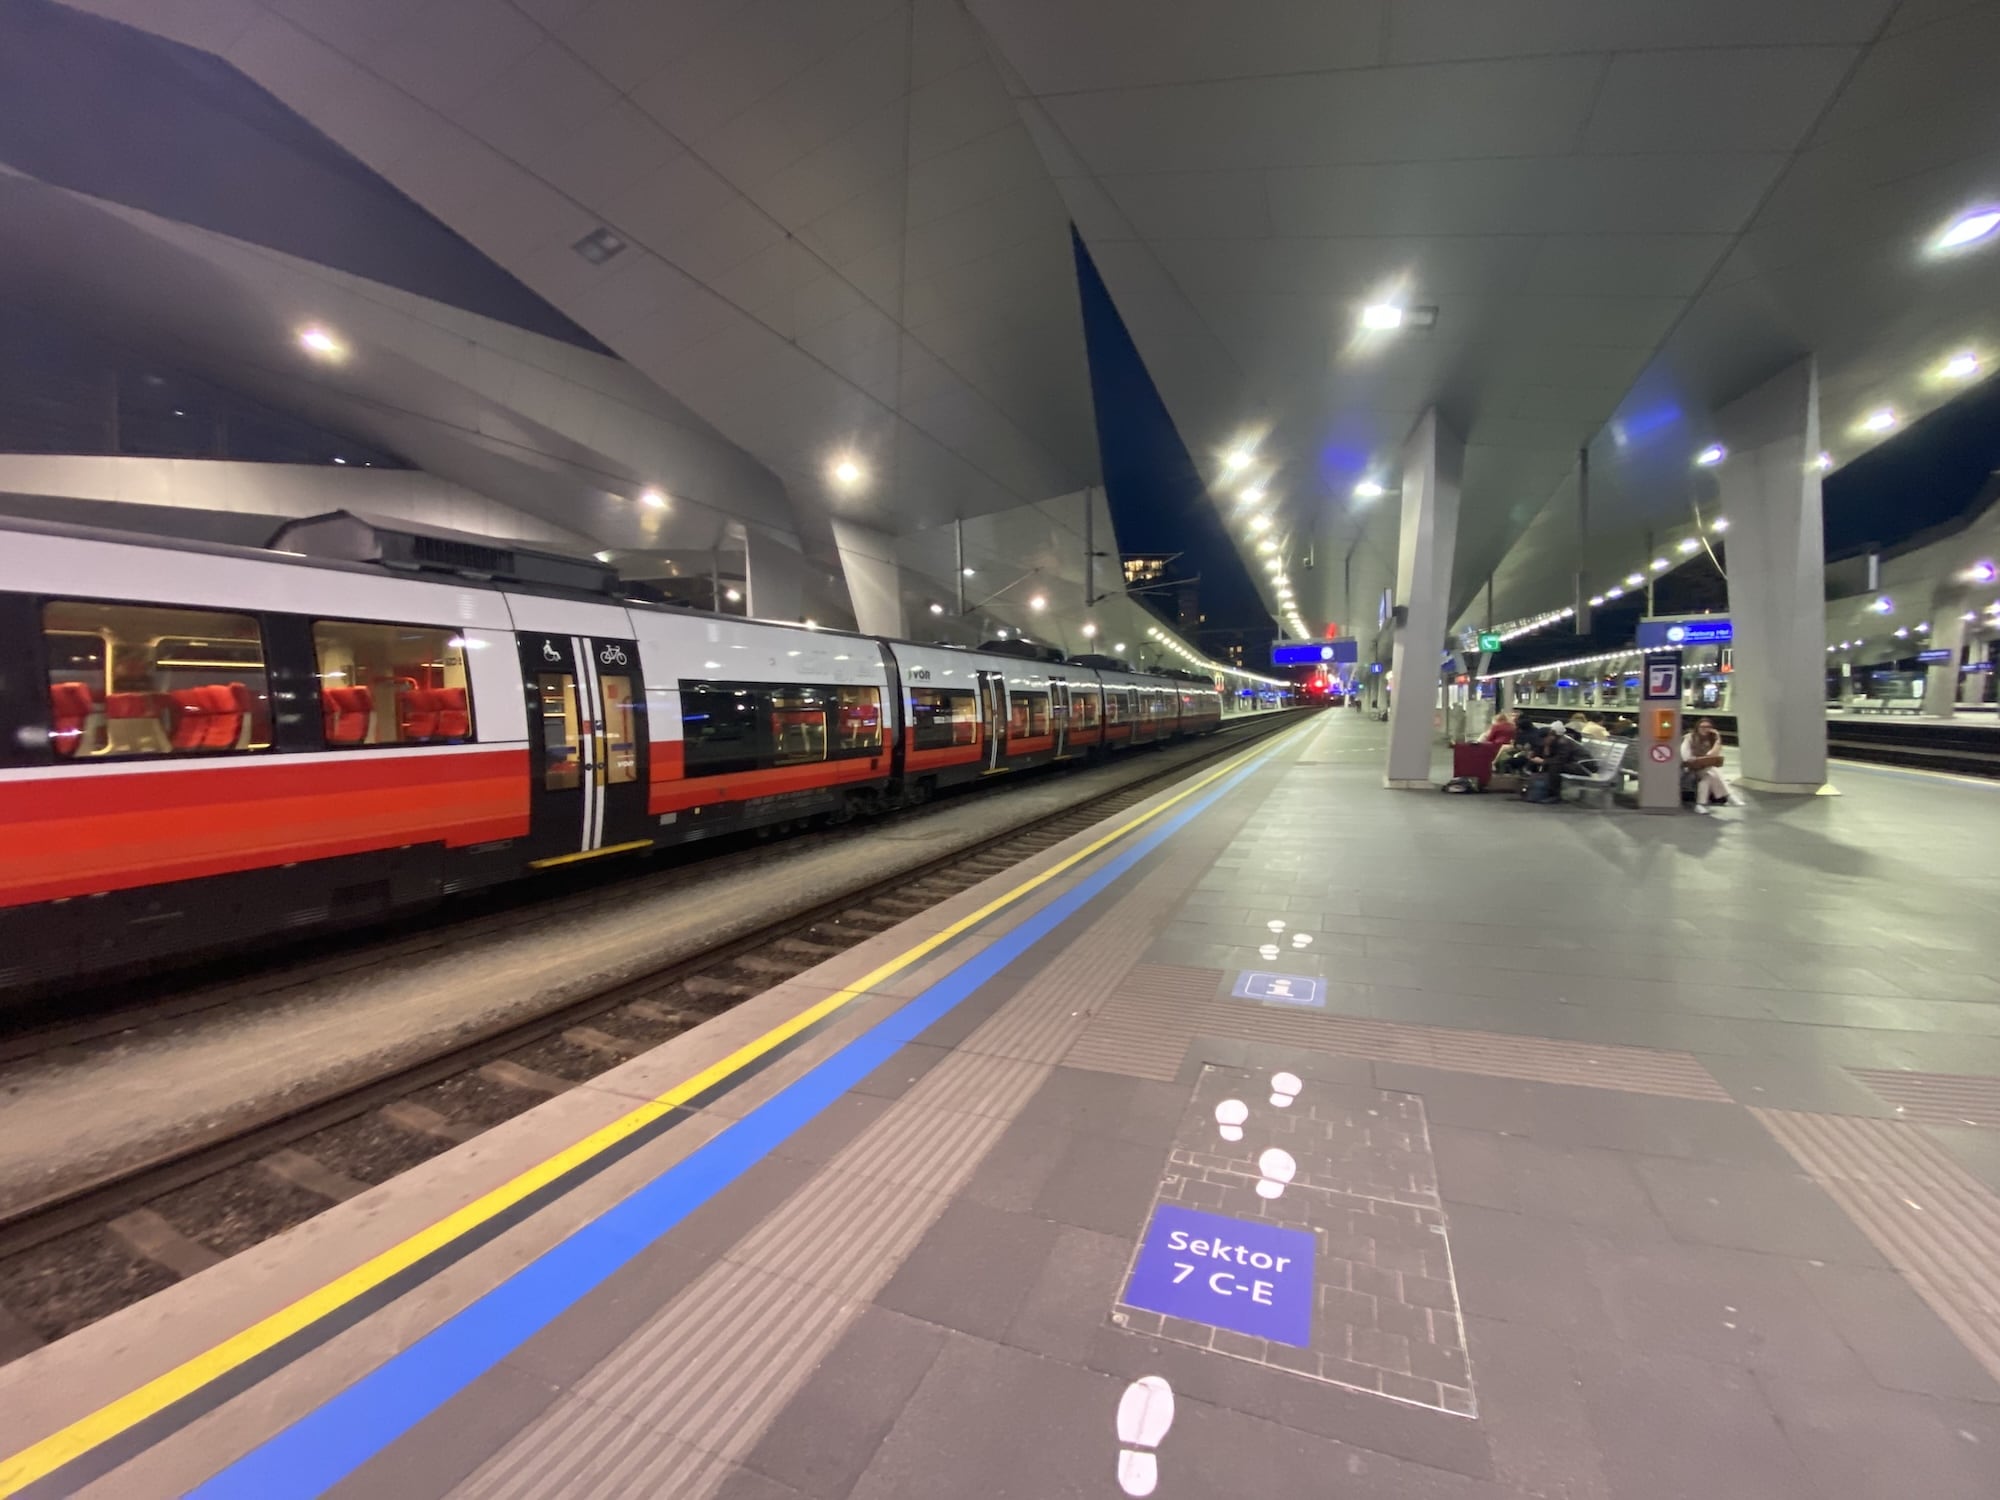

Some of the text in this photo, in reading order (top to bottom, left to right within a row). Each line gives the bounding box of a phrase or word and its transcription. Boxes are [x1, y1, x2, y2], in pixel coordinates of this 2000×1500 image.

[1168, 1231, 1291, 1273] Sektor
[1173, 1262, 1274, 1306] 7 C-E
